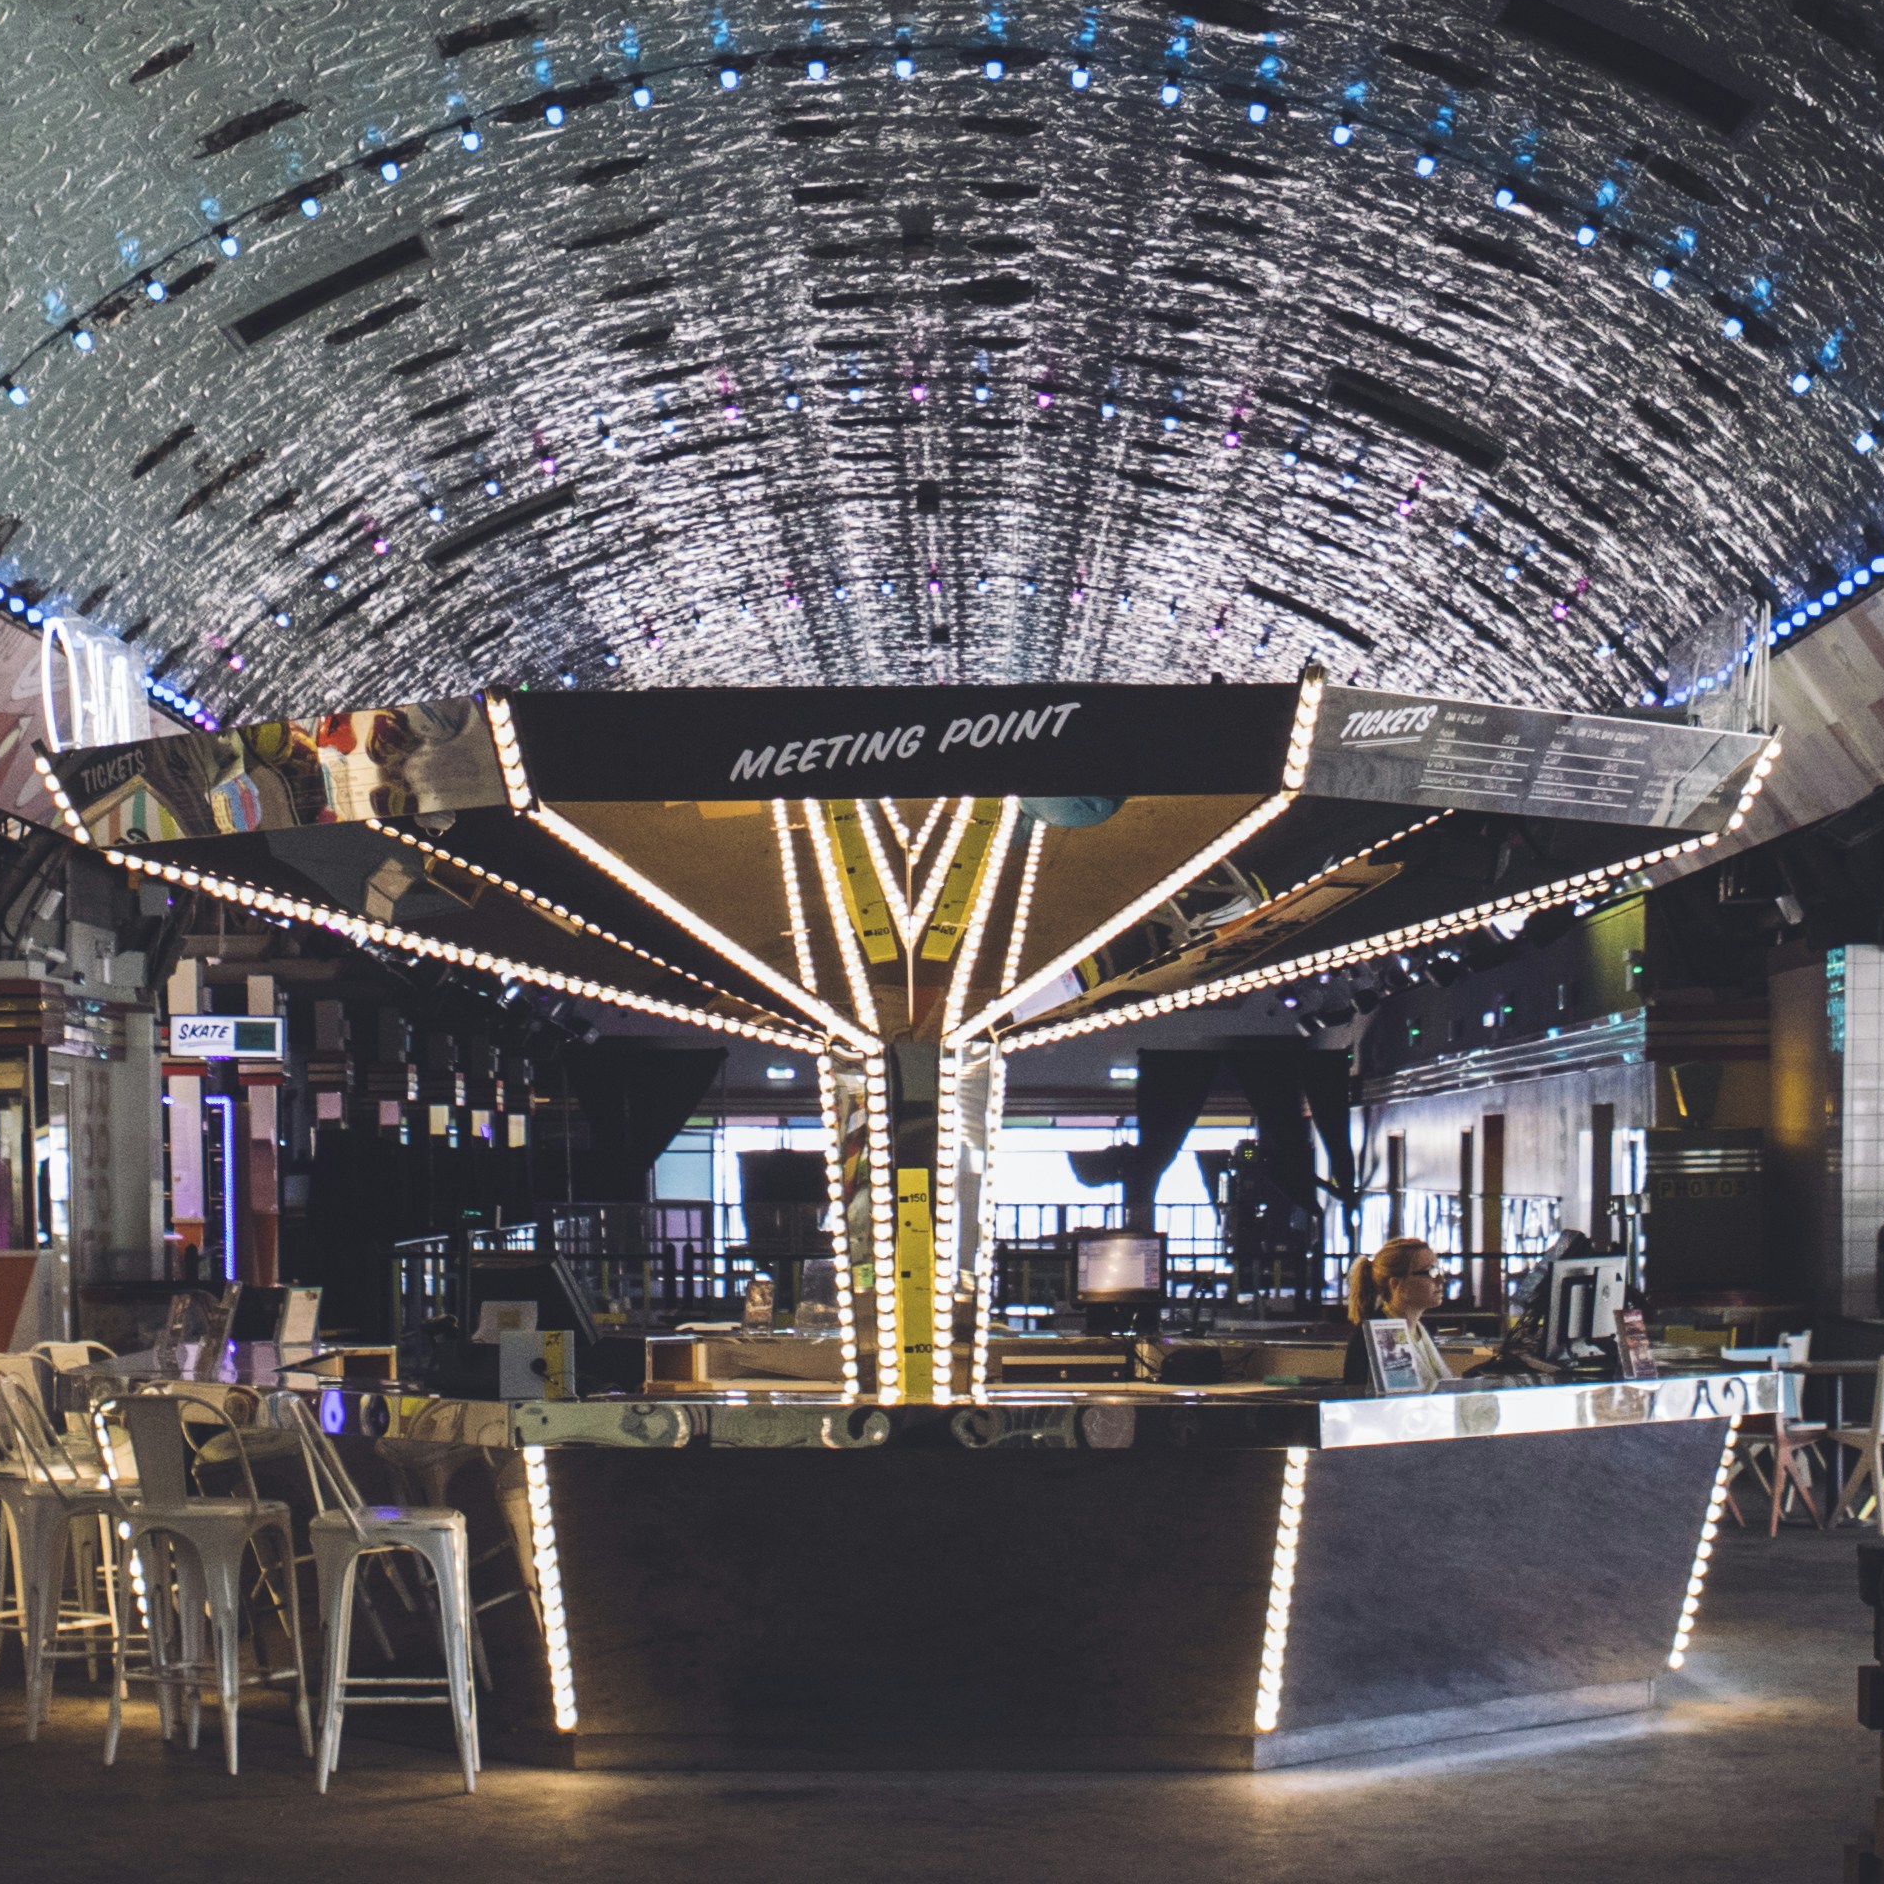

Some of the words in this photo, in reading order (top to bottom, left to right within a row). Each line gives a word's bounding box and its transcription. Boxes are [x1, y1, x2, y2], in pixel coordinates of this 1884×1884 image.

[1340, 705, 1438, 739] TICKETS
[729, 724, 925, 782] MEETING
[938, 702, 1082, 753] POINT
[80, 748, 147, 795] TICKETS
[177, 1023, 230, 1040] SKATE
[909, 1192, 927, 1204] 150
[912, 1343, 934, 1355] 100
